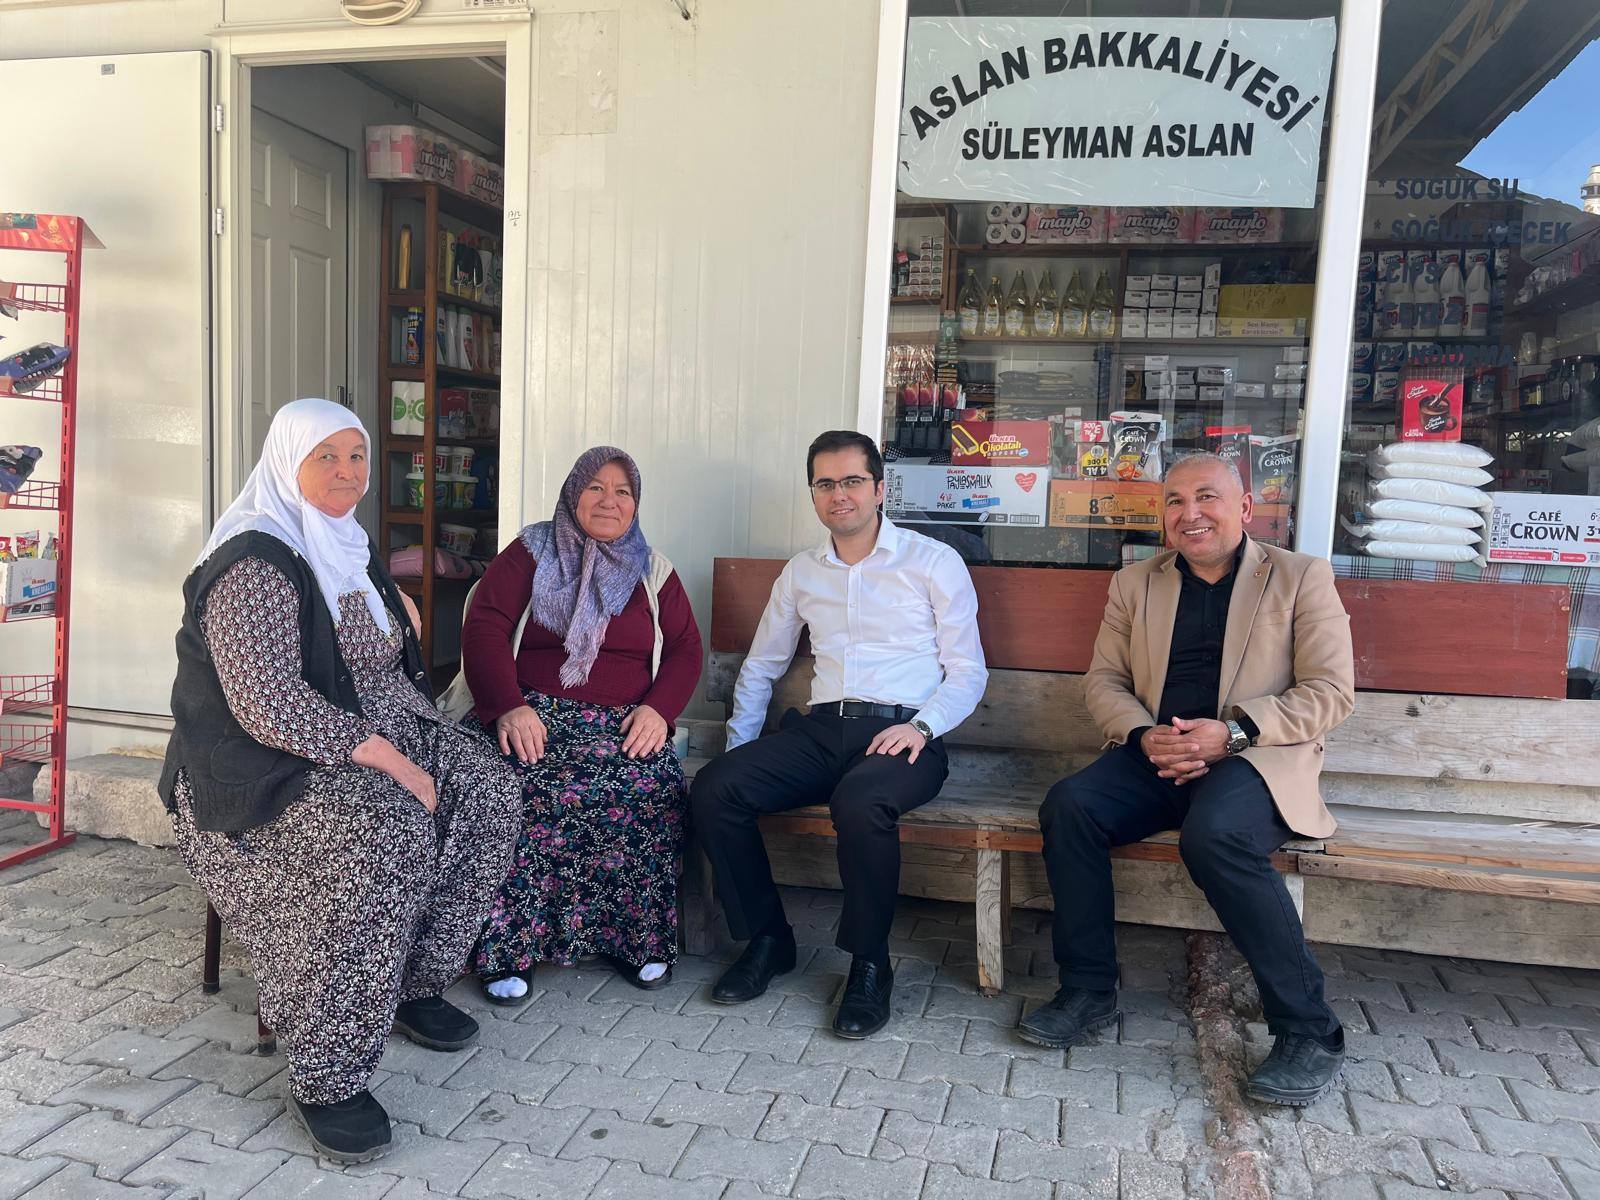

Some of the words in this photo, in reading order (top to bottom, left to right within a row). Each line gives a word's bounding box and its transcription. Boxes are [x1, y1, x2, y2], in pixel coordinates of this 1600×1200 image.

[907, 46, 1031, 140] ASLAN
[1043, 31, 1321, 133] BAKKALİYESİ
[961, 120, 1134, 160] SÜLEYMAN
[1142, 122, 1255, 157] ASLAN
[1487, 177, 1519, 200] SU
[1038, 210, 1092, 236] maylo
[1124, 212, 1179, 236] maylo
[1209, 212, 1268, 238] maylo
[1120, 435, 1147, 443] CROWN
[1086, 466, 1098, 475] AL
[1264, 457, 1293, 467] CROWN
[1528, 510, 1562, 522] CAFÉ
[1510, 523, 1580, 541] CROWN
